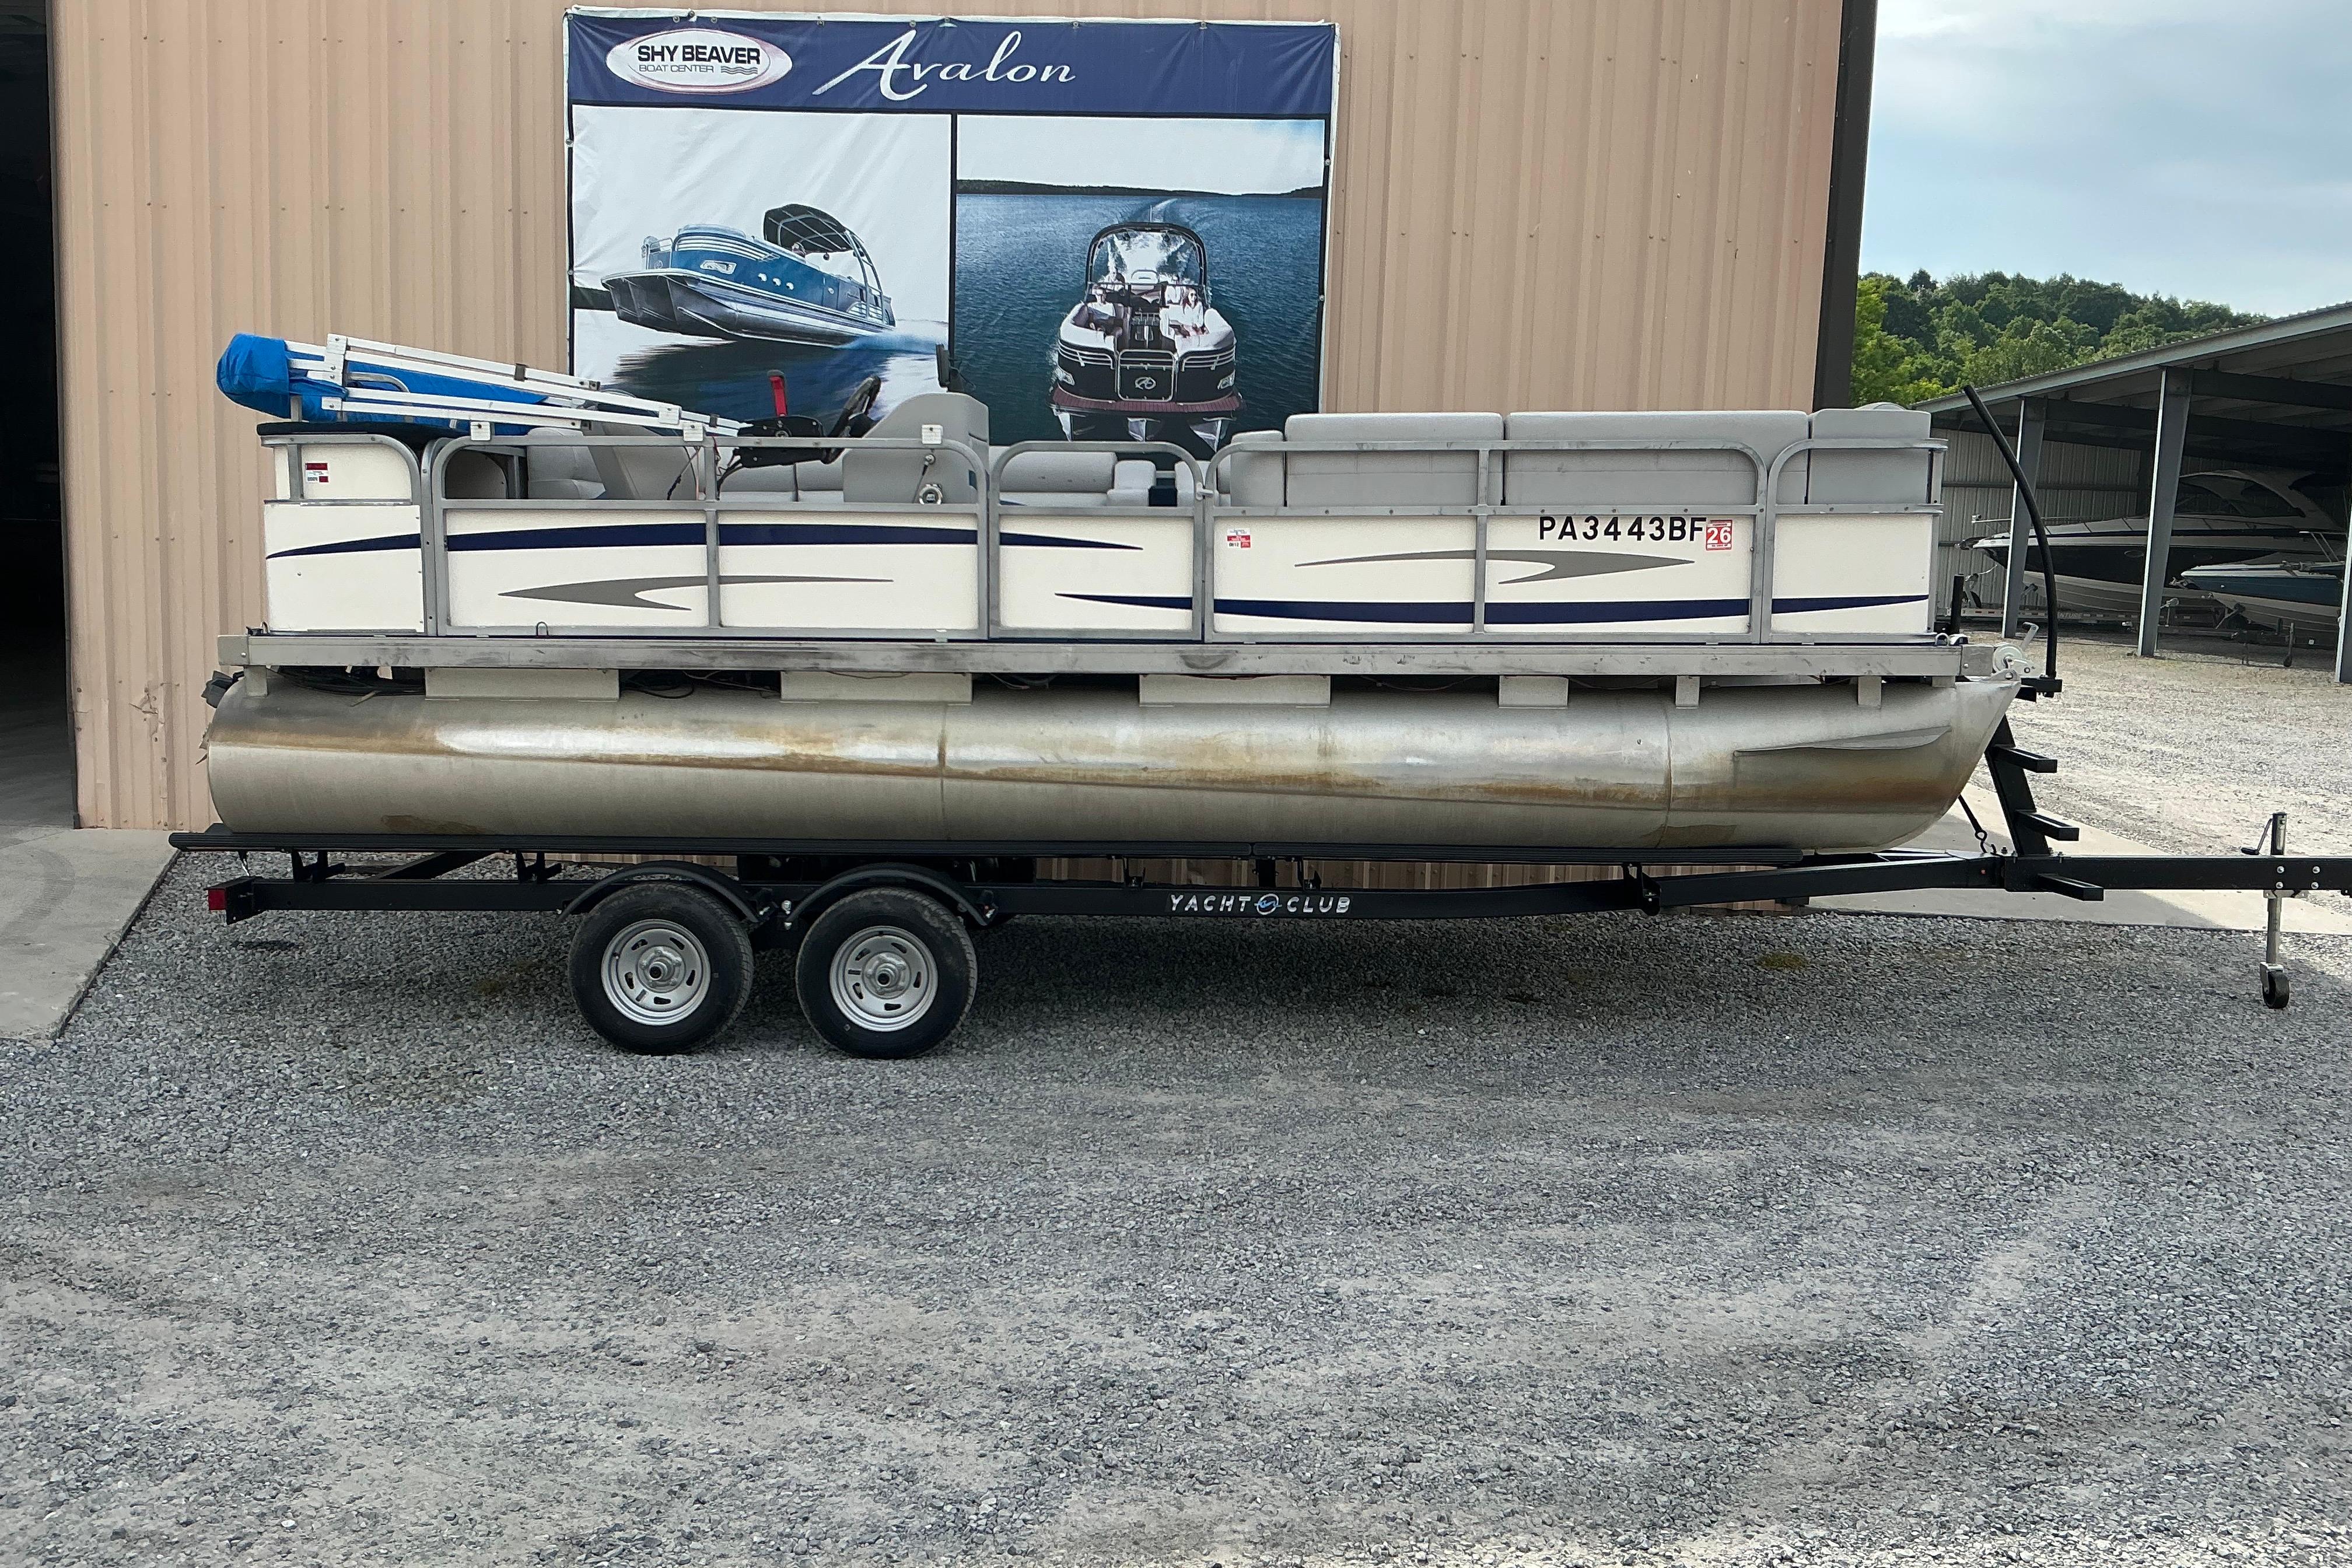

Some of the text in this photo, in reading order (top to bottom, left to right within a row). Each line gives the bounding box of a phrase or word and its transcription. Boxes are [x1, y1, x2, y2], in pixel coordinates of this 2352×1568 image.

[638, 45, 761, 65] SHY BEAVER
[639, 64, 714, 73] BOAT CENTER
[811, 29, 1076, 102] Avalon
[1539, 516, 1707, 542] PA3443BF
[1707, 527, 1731, 544] 26
[1170, 894, 1351, 914] YACHT CLUB
